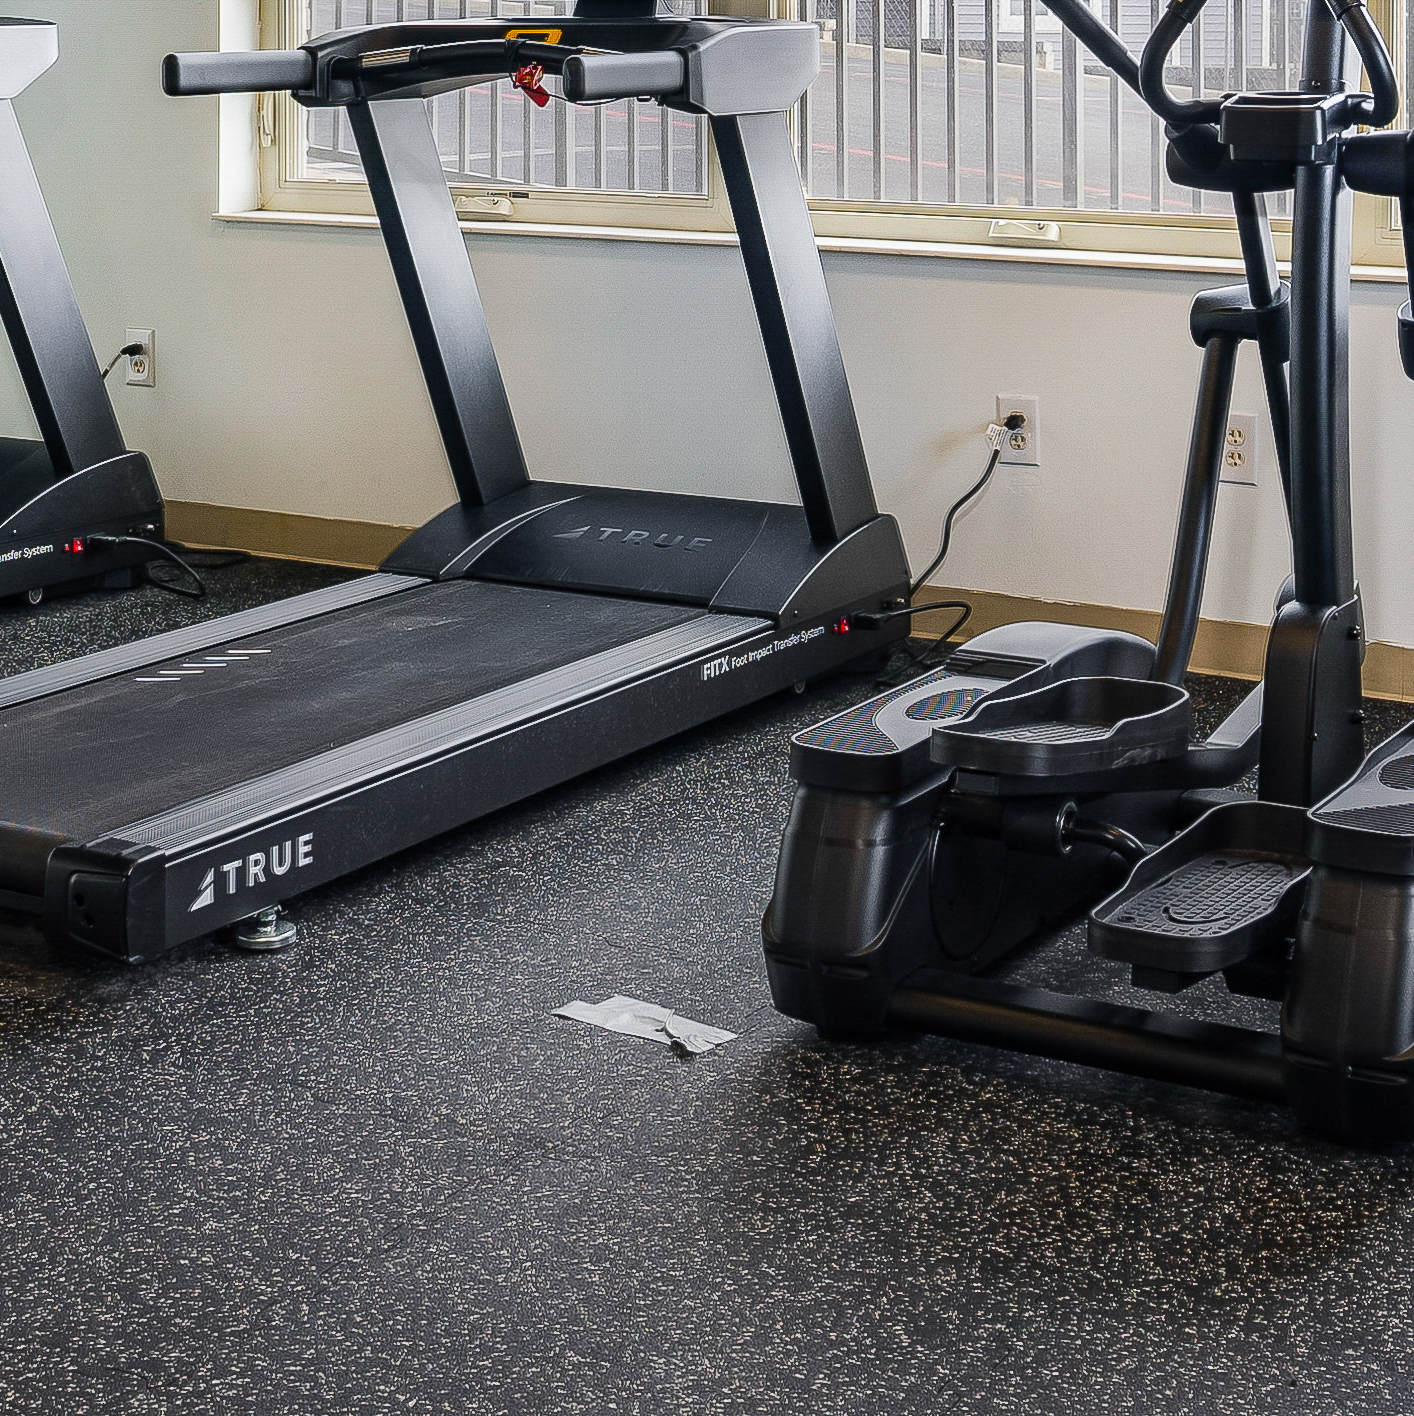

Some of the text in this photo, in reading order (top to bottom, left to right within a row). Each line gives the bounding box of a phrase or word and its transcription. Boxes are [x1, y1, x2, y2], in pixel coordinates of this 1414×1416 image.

[23, 543, 54, 560] System
[598, 527, 713, 552] TRUE
[702, 626, 825, 681] FITX Foot Impact Transfer System
[220, 832, 314, 895] TRUE
